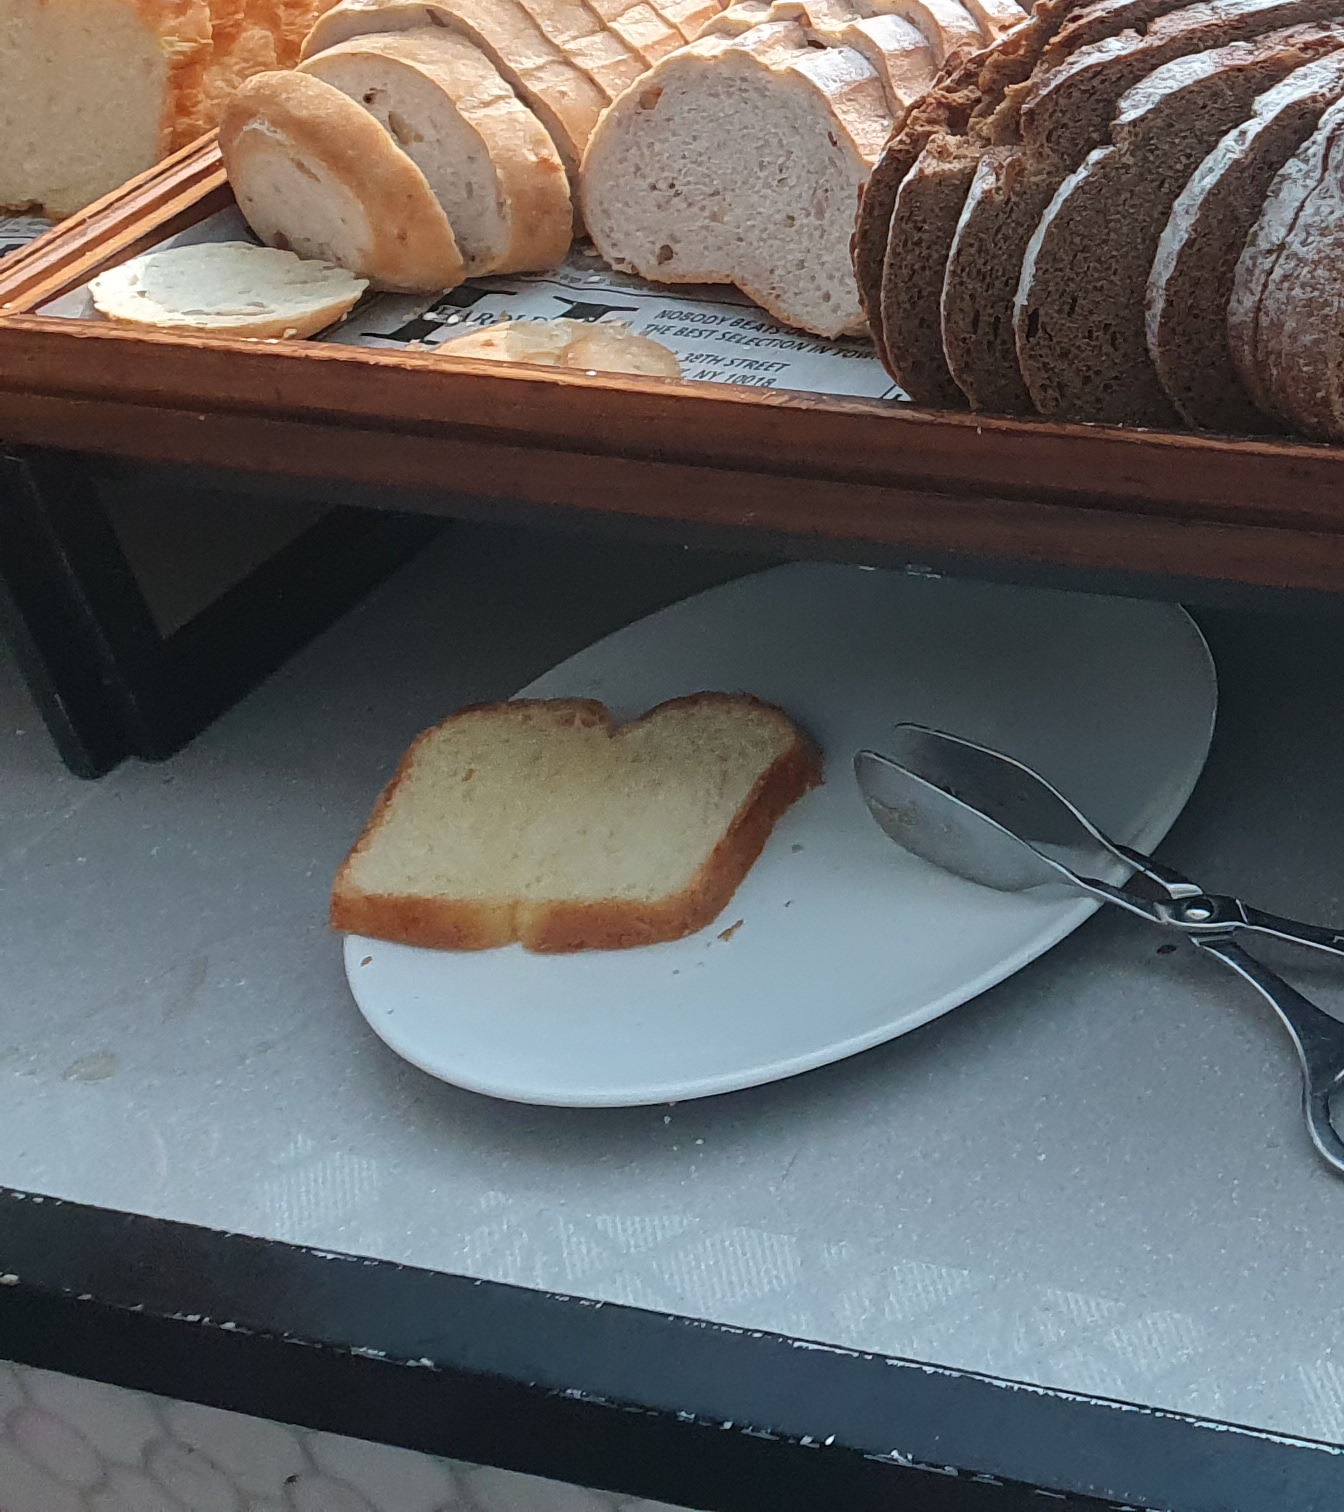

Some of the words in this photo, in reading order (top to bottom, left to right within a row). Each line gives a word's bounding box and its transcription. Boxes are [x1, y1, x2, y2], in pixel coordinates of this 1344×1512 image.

[653, 309, 731, 326] NOBODY
[672, 327, 720, 340] BEST
[714, 331, 810, 351] SELECTION
[806, 342, 832, 355] IN
[723, 358, 791, 373] STREET
[692, 369, 724, 381] NY
